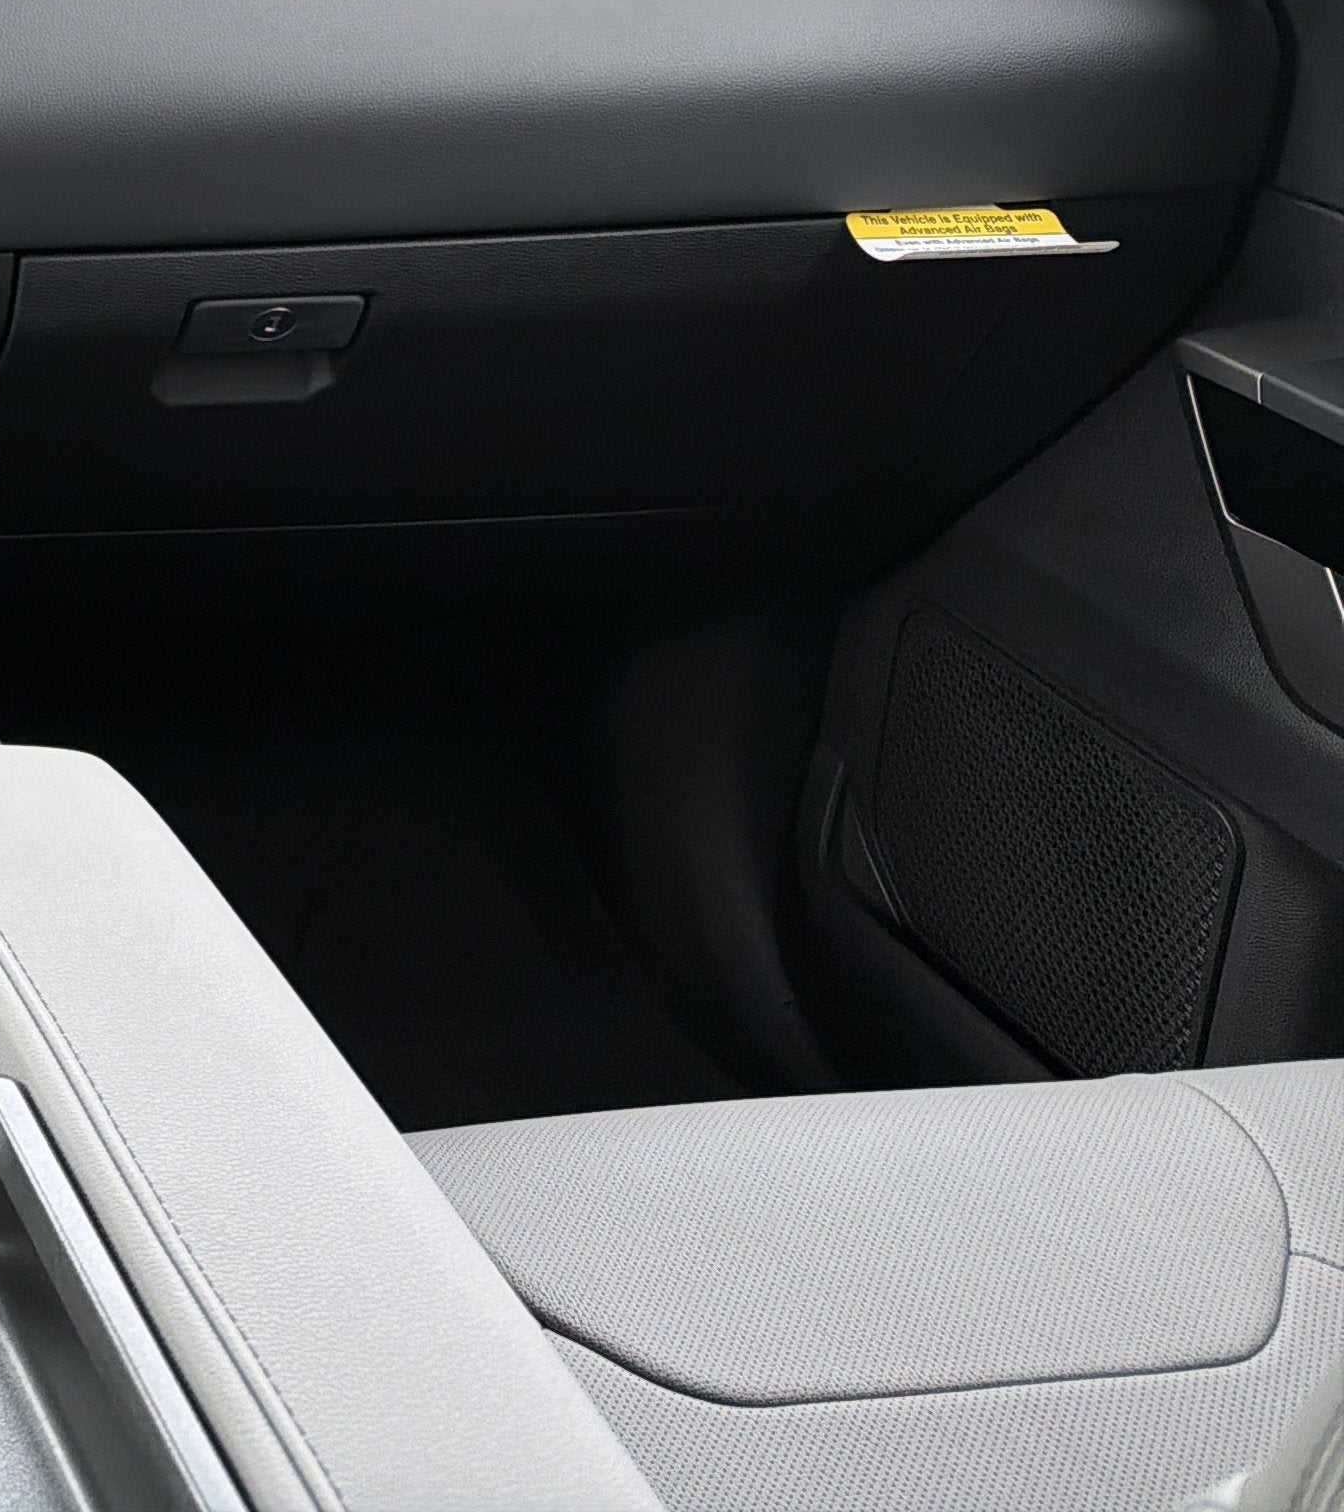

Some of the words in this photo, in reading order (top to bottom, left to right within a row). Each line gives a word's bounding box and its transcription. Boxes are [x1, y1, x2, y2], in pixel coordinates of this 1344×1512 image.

[861, 215, 889, 226] This
[892, 214, 936, 226] Vehicle
[940, 214, 950, 224] is
[954, 213, 1014, 226] Equipped
[1017, 212, 1042, 223] with
[900, 225, 962, 236] Advanced
[965, 225, 981, 234] Air
[987, 224, 1018, 236] Bags
[895, 238, 923, 246] Even
[945, 237, 993, 245] Advanced
[1012, 236, 1039, 246] Bags
